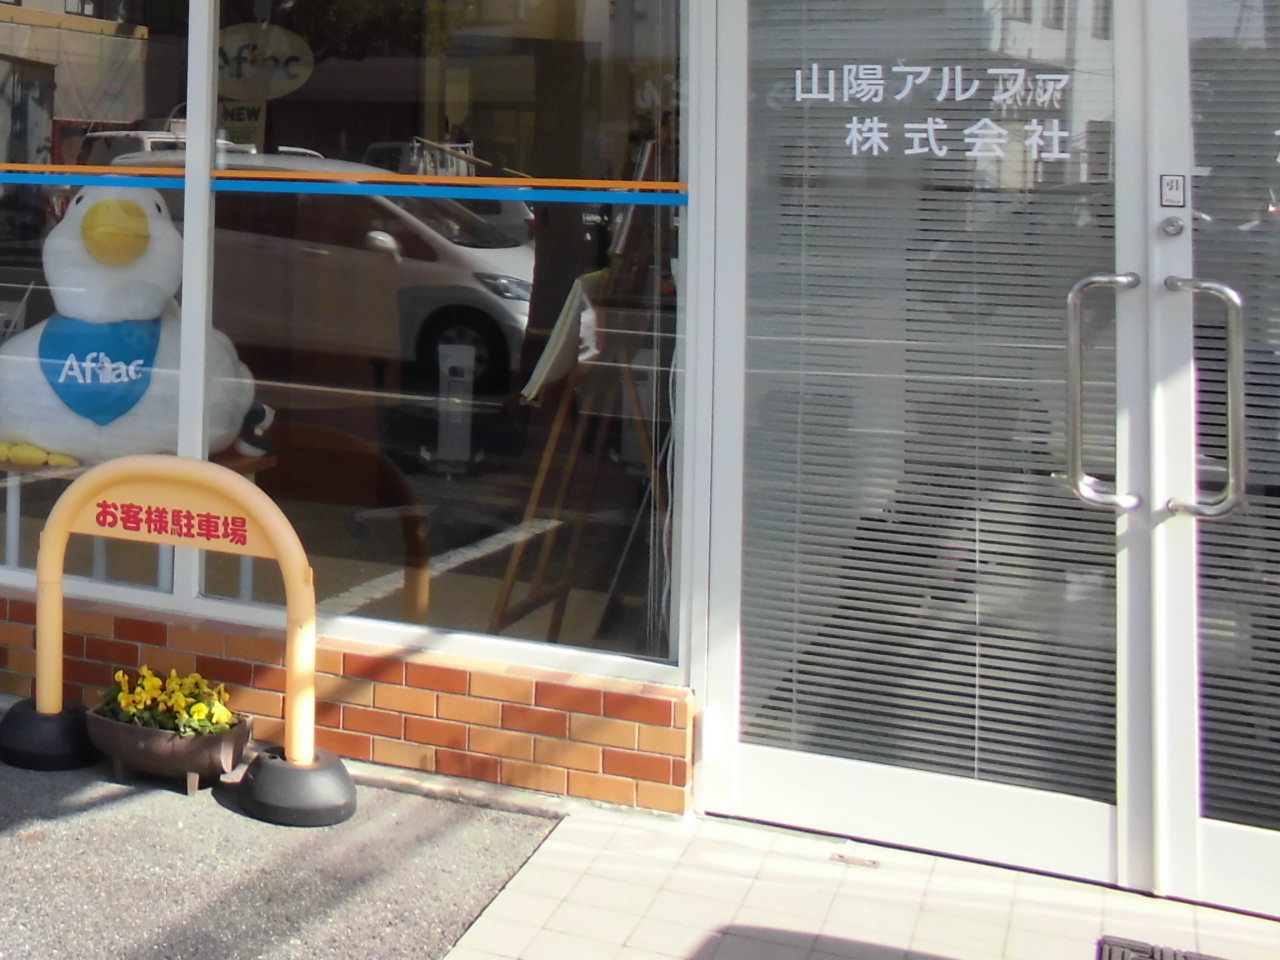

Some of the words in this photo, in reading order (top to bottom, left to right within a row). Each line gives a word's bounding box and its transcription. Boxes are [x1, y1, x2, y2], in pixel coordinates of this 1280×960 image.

[795, 63, 1069, 104] 山陽アルファ
[224, 107, 261, 121] NEW
[845, 116, 1070, 159] 株式会社
[95, 500, 248, 546] お客様駐車場
